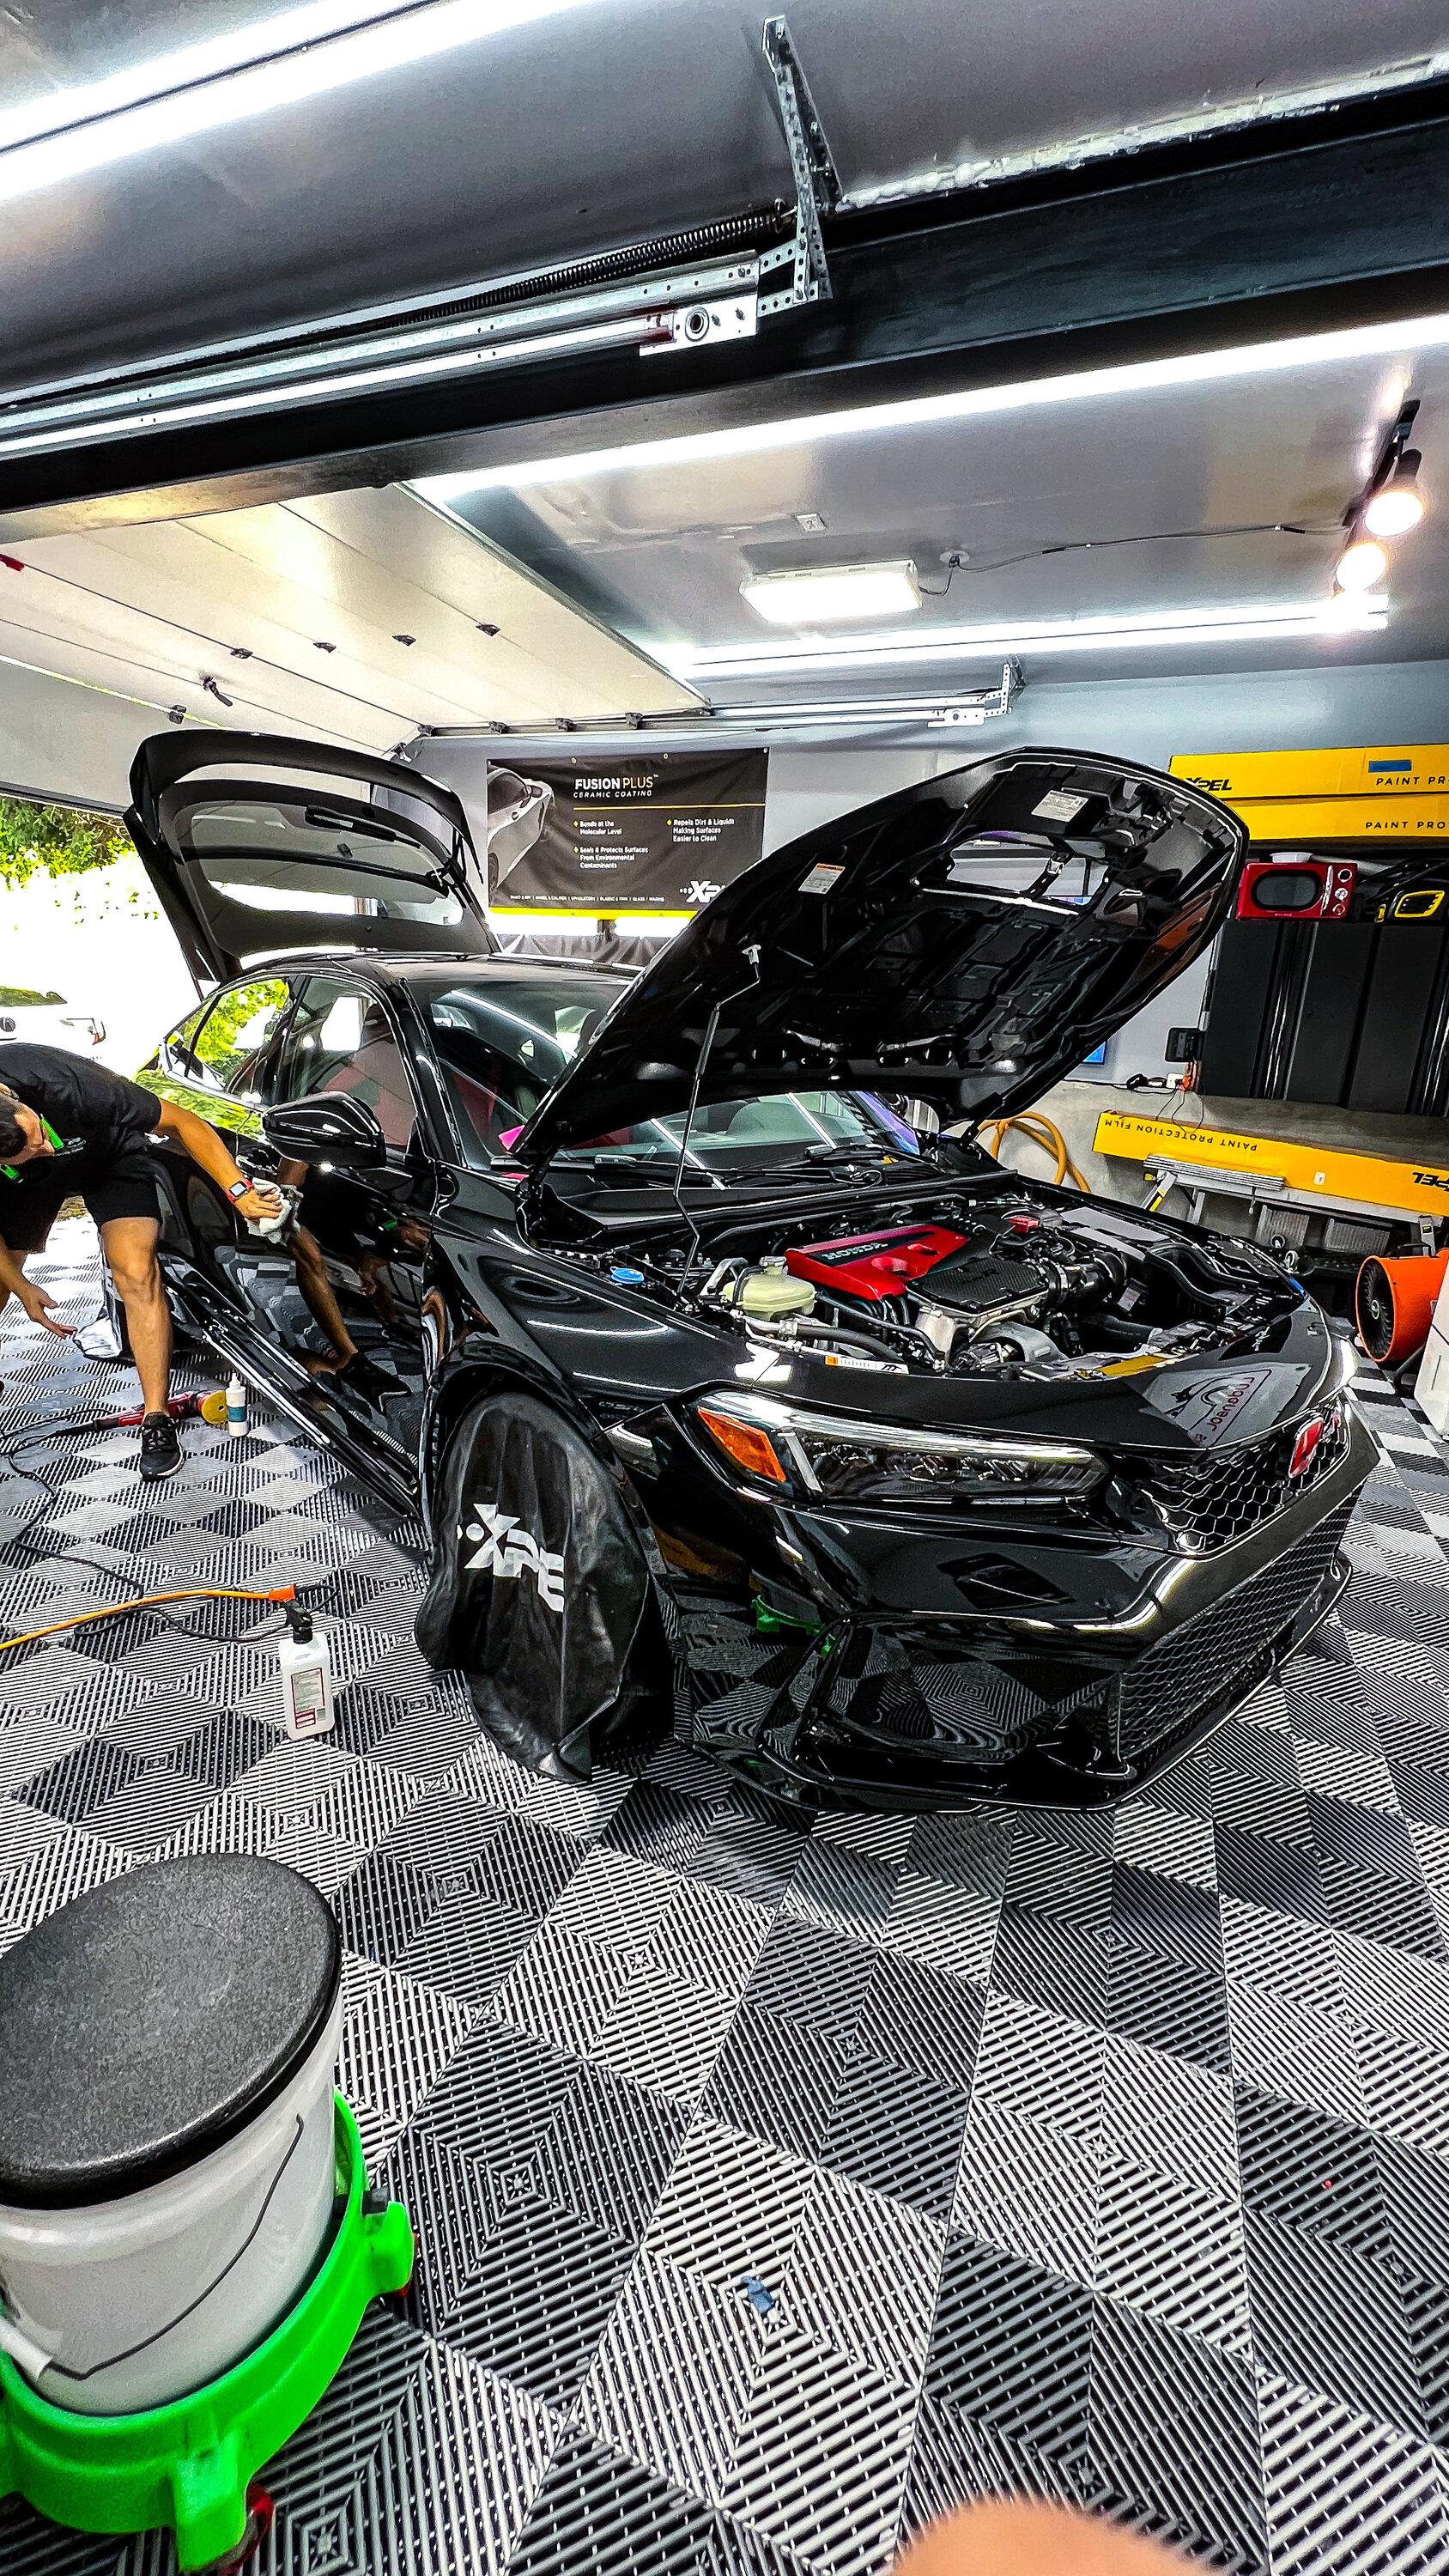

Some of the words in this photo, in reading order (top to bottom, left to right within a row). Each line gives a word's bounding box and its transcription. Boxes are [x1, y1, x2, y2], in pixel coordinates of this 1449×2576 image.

[574, 777, 621, 790] FUSION
[1376, 776, 1420, 785] PAINT
[615, 790, 652, 799] COATING
[1365, 821, 1409, 829] PAINT
[1416, 821, 1449, 829] PRO
[1105, 1119, 1131, 1130] FILM
[1137, 1125, 1213, 1144] PROTECTION
[1220, 1135, 1258, 1151] PAINT
